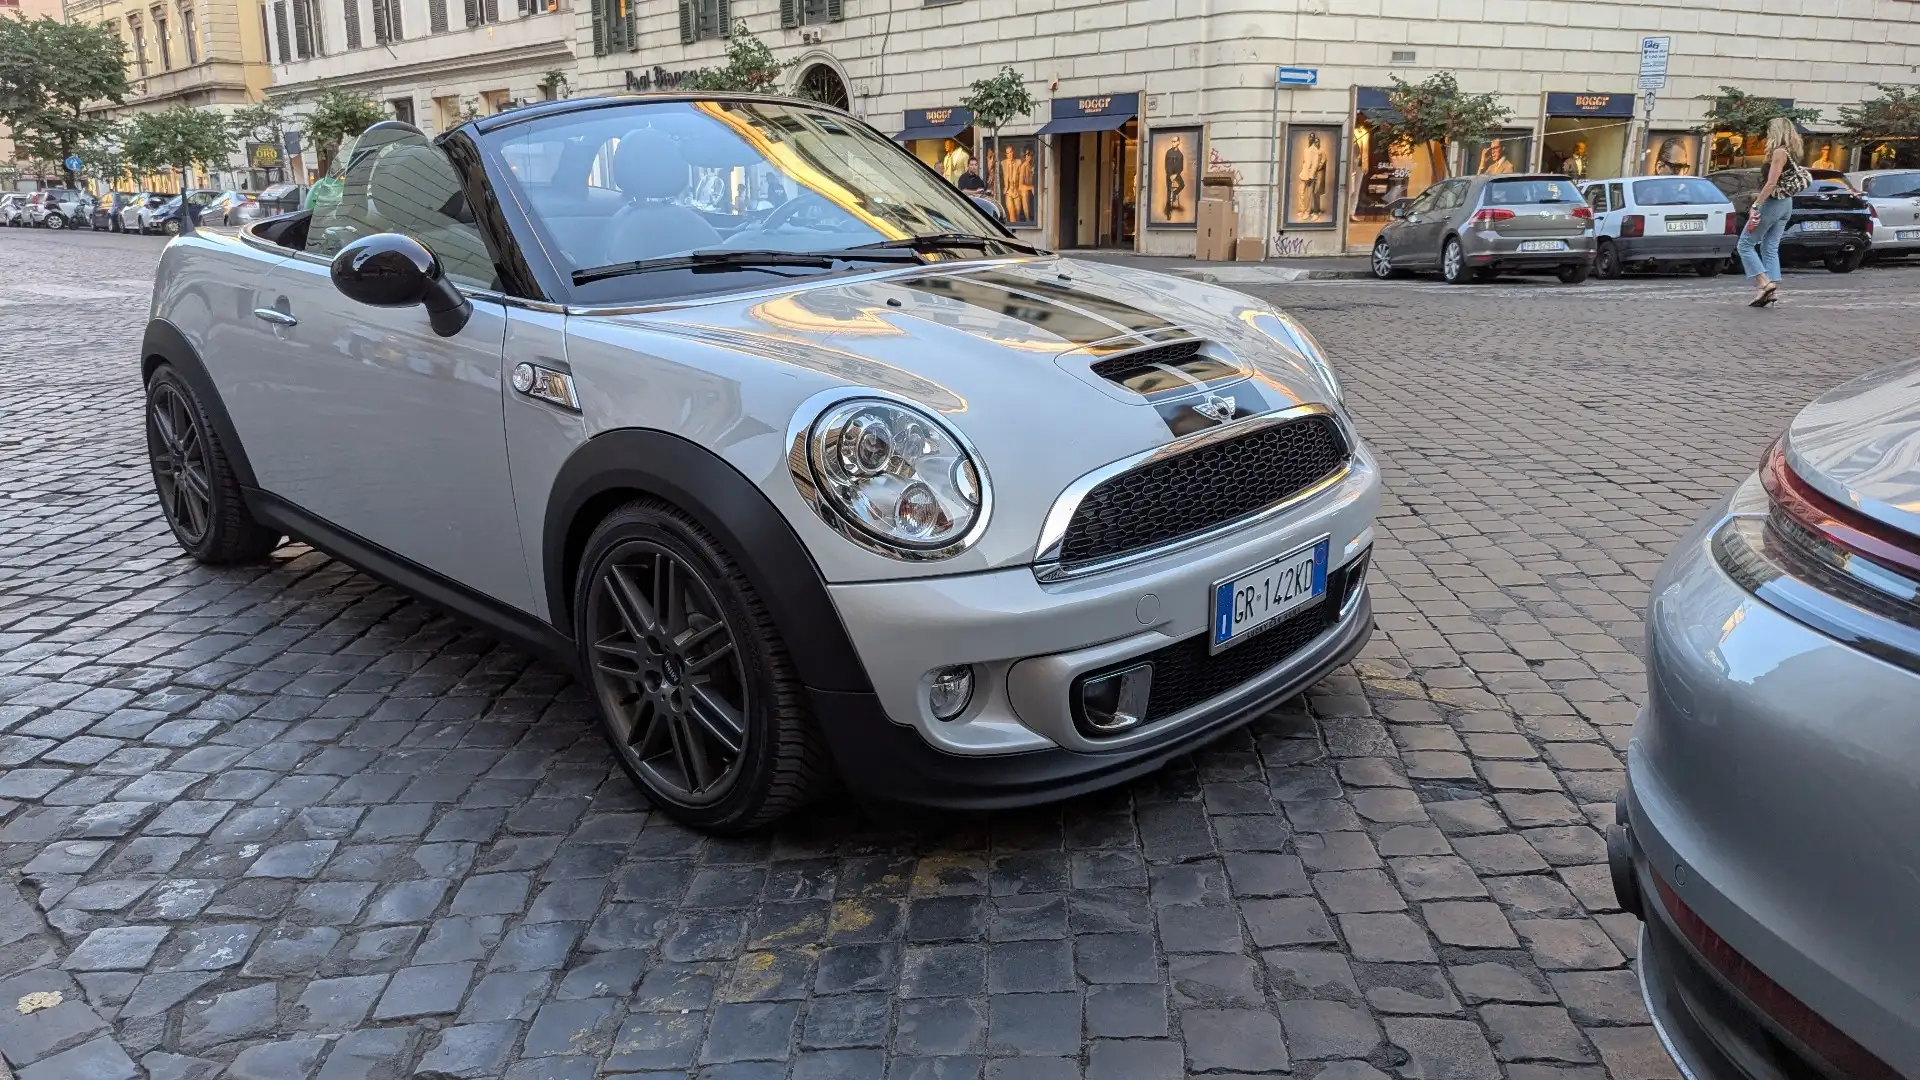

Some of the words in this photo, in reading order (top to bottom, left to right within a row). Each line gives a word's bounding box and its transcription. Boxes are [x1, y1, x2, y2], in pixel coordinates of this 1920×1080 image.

[1079, 97, 1111, 109] BOGGI
[1576, 96, 1609, 106] BOGGI
[926, 109, 952, 120] BOGGI
